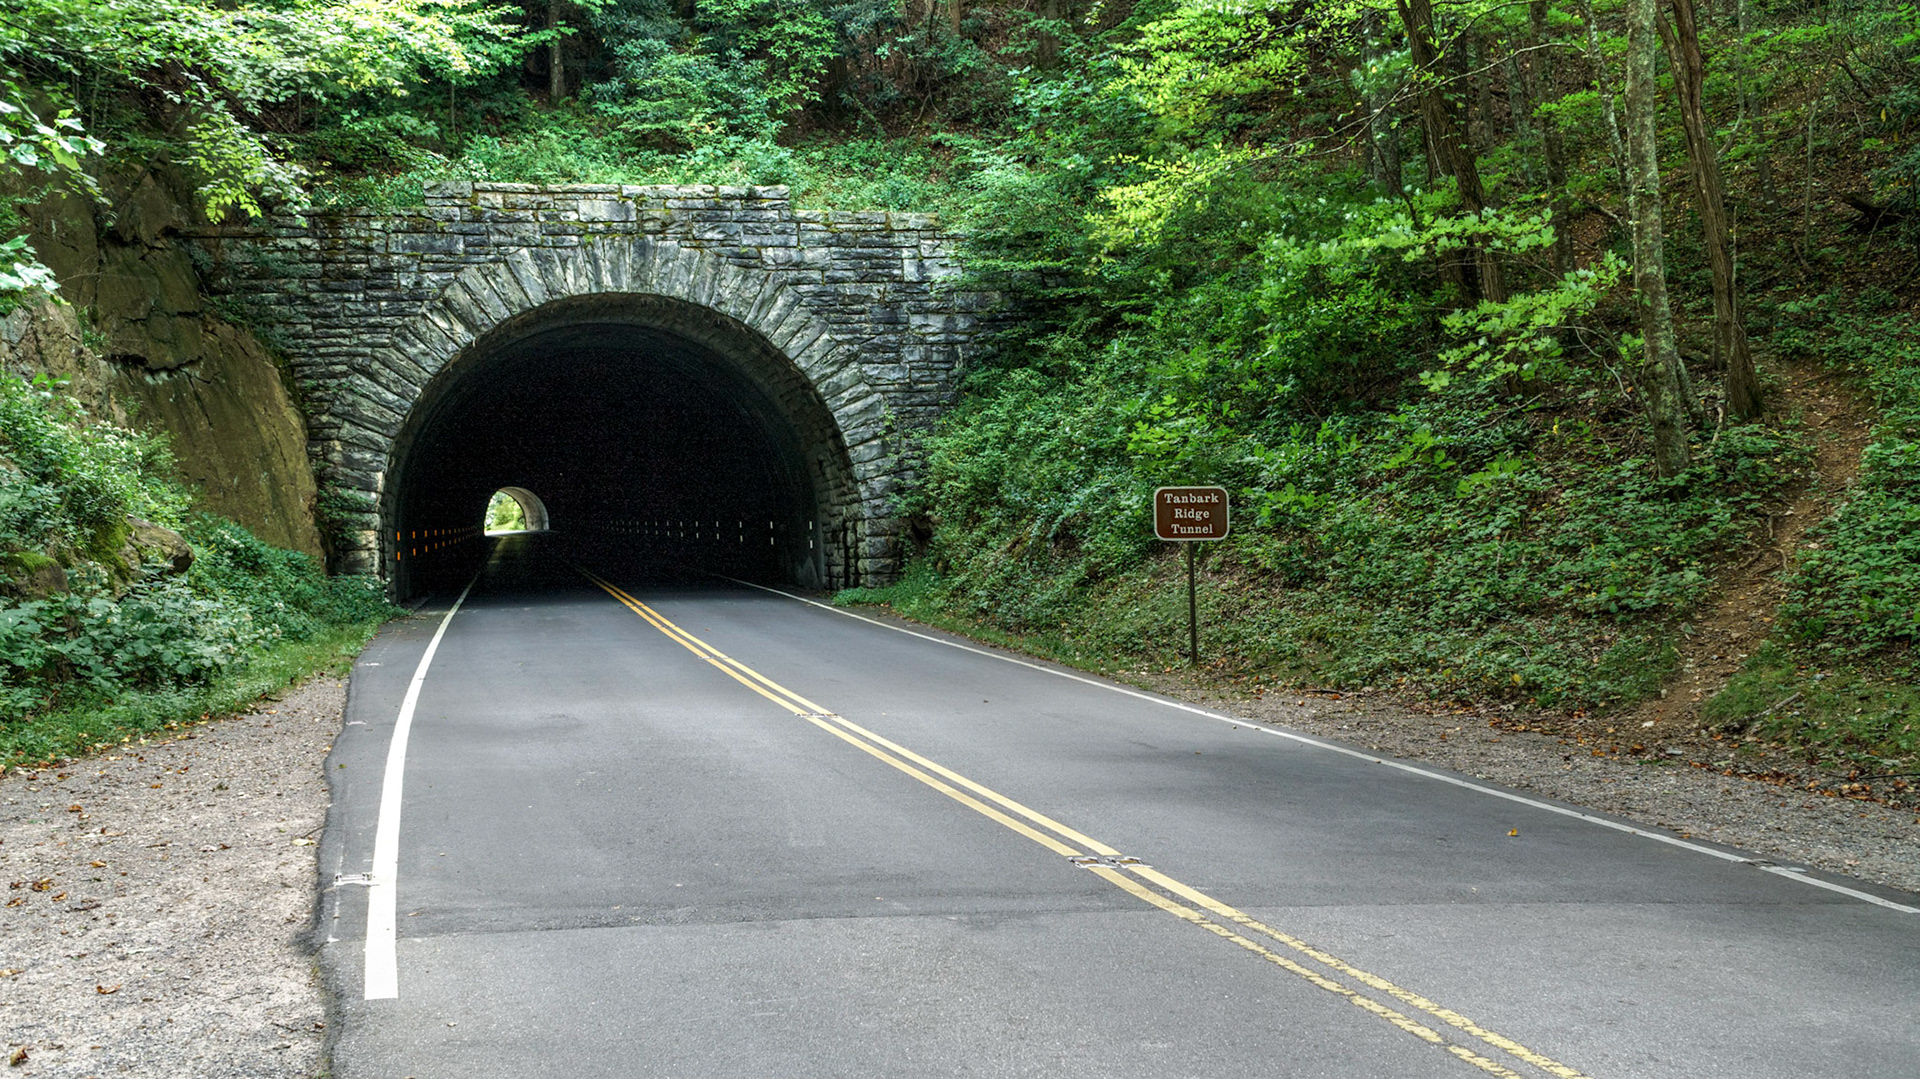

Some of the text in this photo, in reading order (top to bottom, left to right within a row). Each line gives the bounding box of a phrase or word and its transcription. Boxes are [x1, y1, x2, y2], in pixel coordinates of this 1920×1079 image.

[1164, 493, 1219, 504] Tanbark
[1174, 508, 1210, 521] Ridge
[1171, 524, 1213, 534] Tunnel
